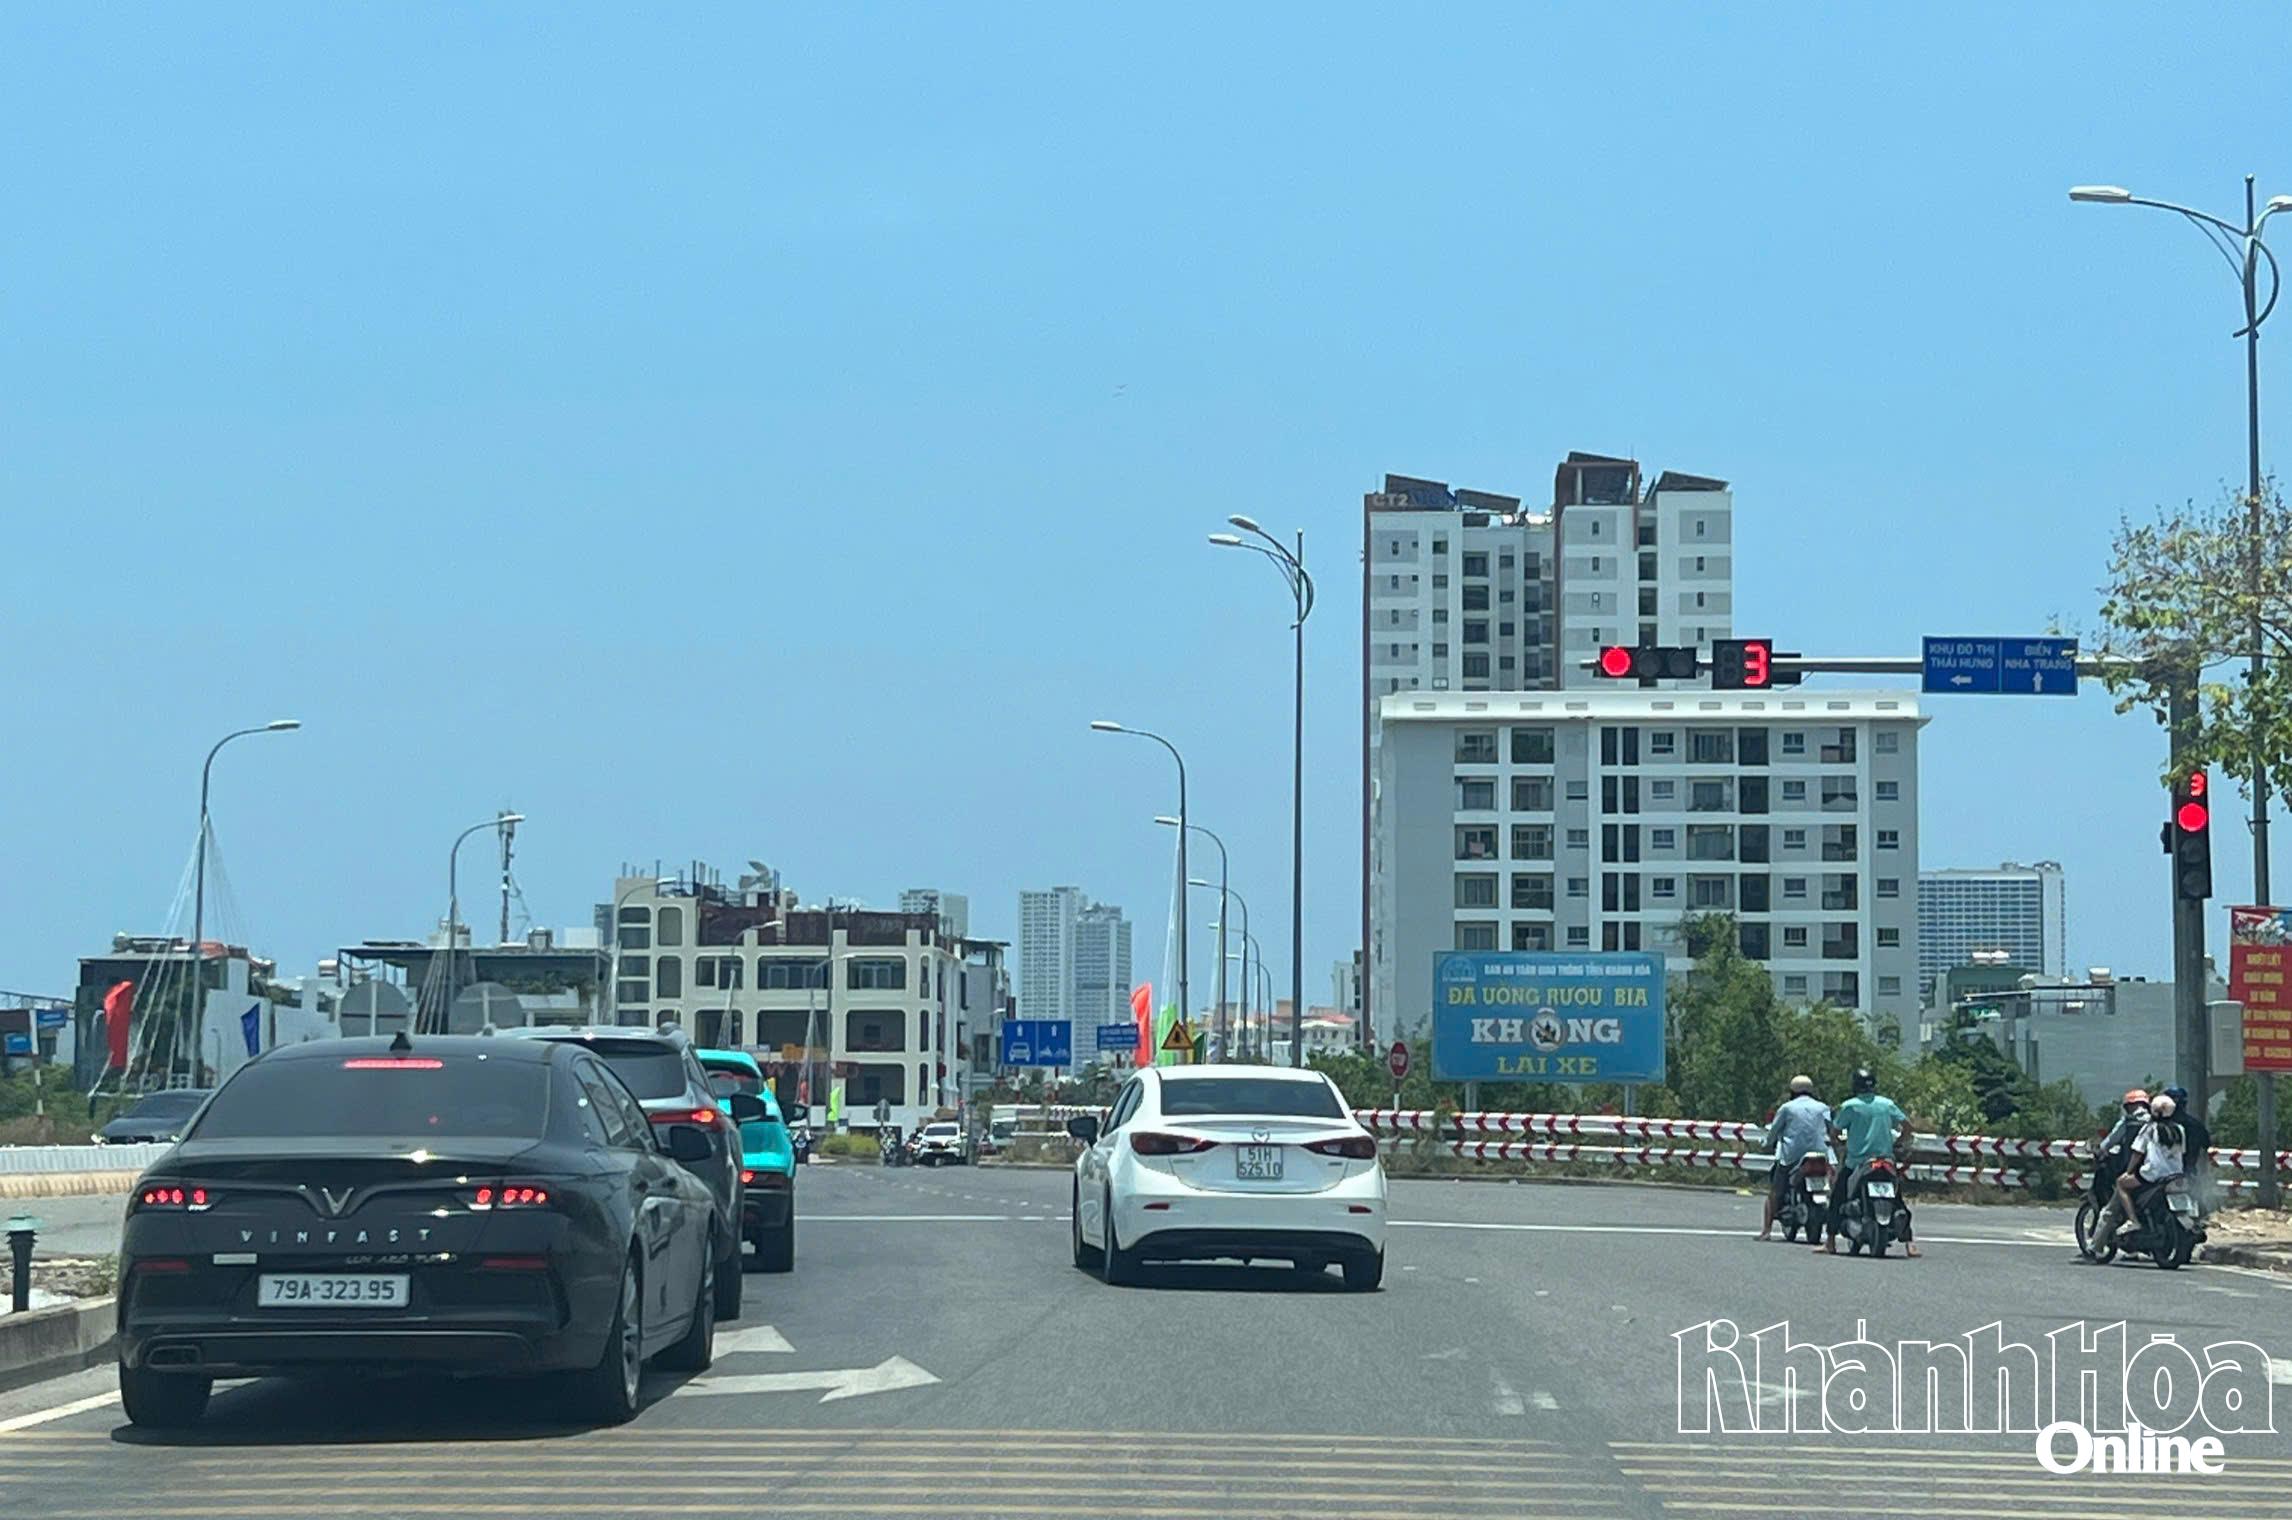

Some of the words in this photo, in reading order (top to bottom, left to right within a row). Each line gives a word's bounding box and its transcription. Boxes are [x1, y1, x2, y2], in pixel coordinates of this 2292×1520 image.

[1743, 641, 1768, 685] 3
[2005, 658, 2030, 670] NHA
[2032, 658, 2073, 671] TRANG
[2190, 771, 2205, 797] 3
[1614, 987, 1648, 1006] BIA
[1556, 1056, 1597, 1075] XE
[1248, 1146, 1273, 1161] 51H
[240, 1229, 431, 1243] VINFAST
[272, 1279, 395, 1301] 79A-323.95
